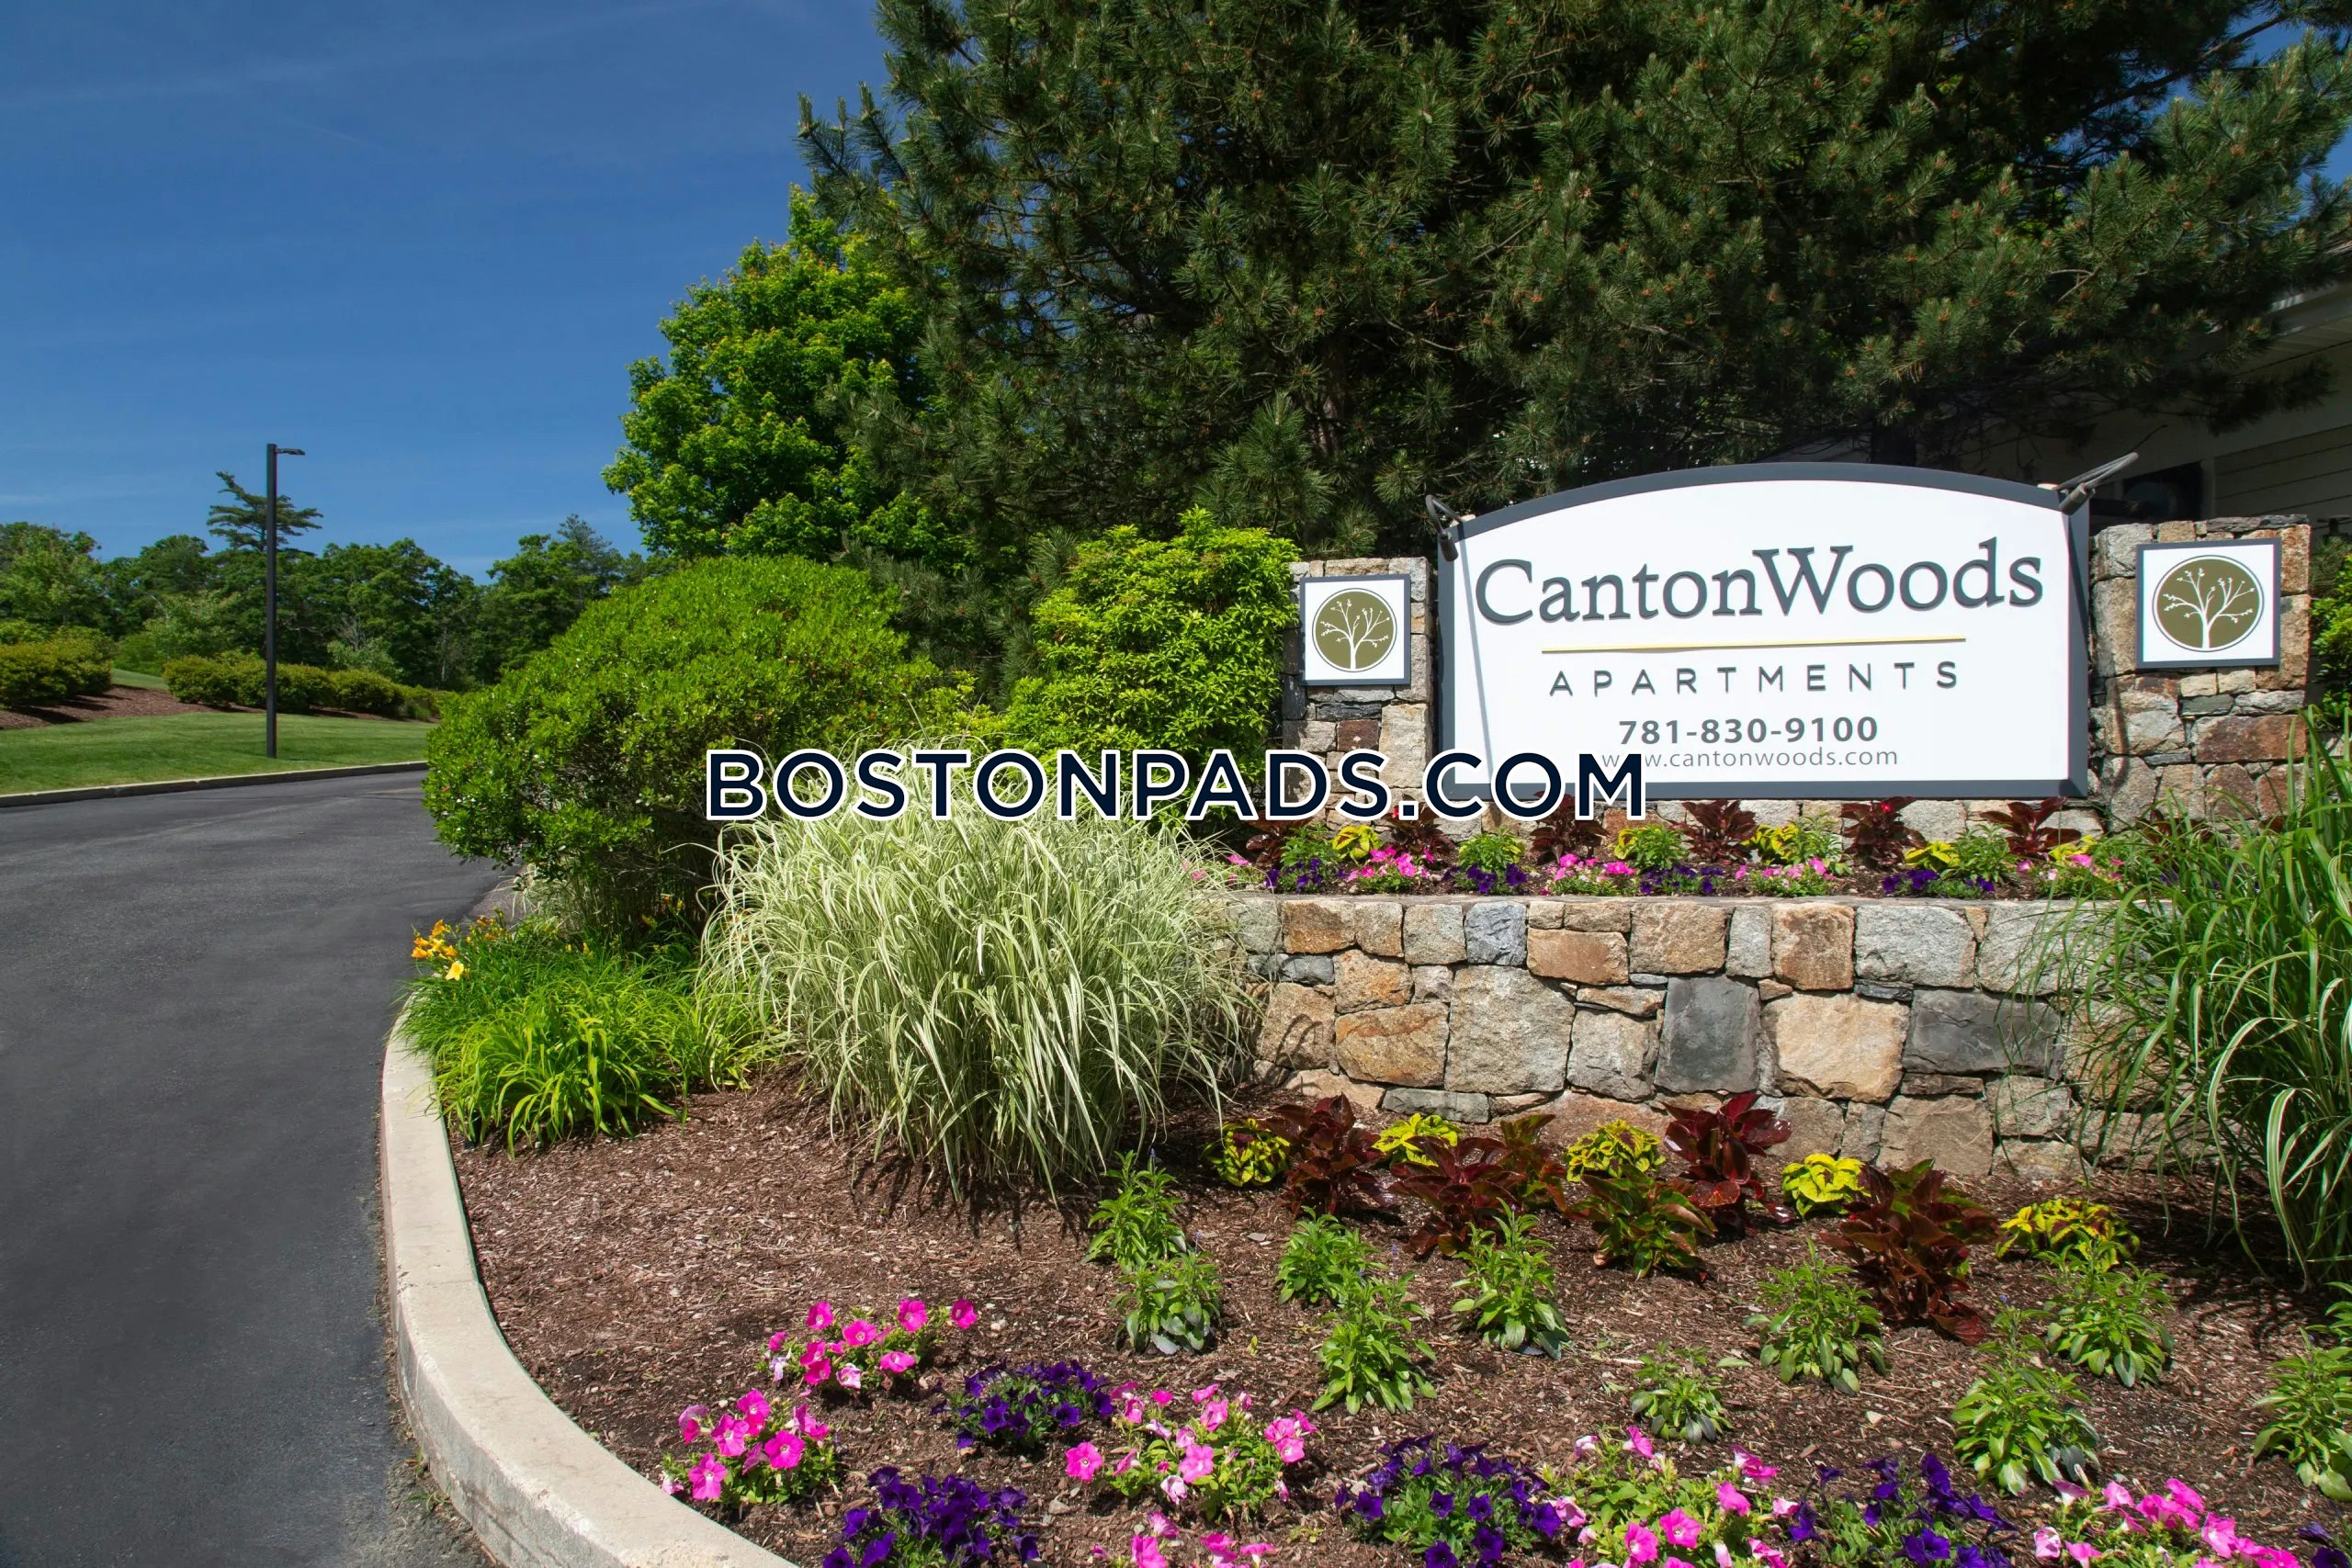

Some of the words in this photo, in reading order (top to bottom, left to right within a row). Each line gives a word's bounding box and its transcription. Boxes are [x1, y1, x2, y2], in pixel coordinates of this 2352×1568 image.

[1476, 536, 2044, 626] CantonWoods
[1549, 661, 1958, 697] APARTMENTS
[1619, 716, 1878, 746] 781-830-9100
[1601, 746, 1898, 768] ww.cantonwoods.com
